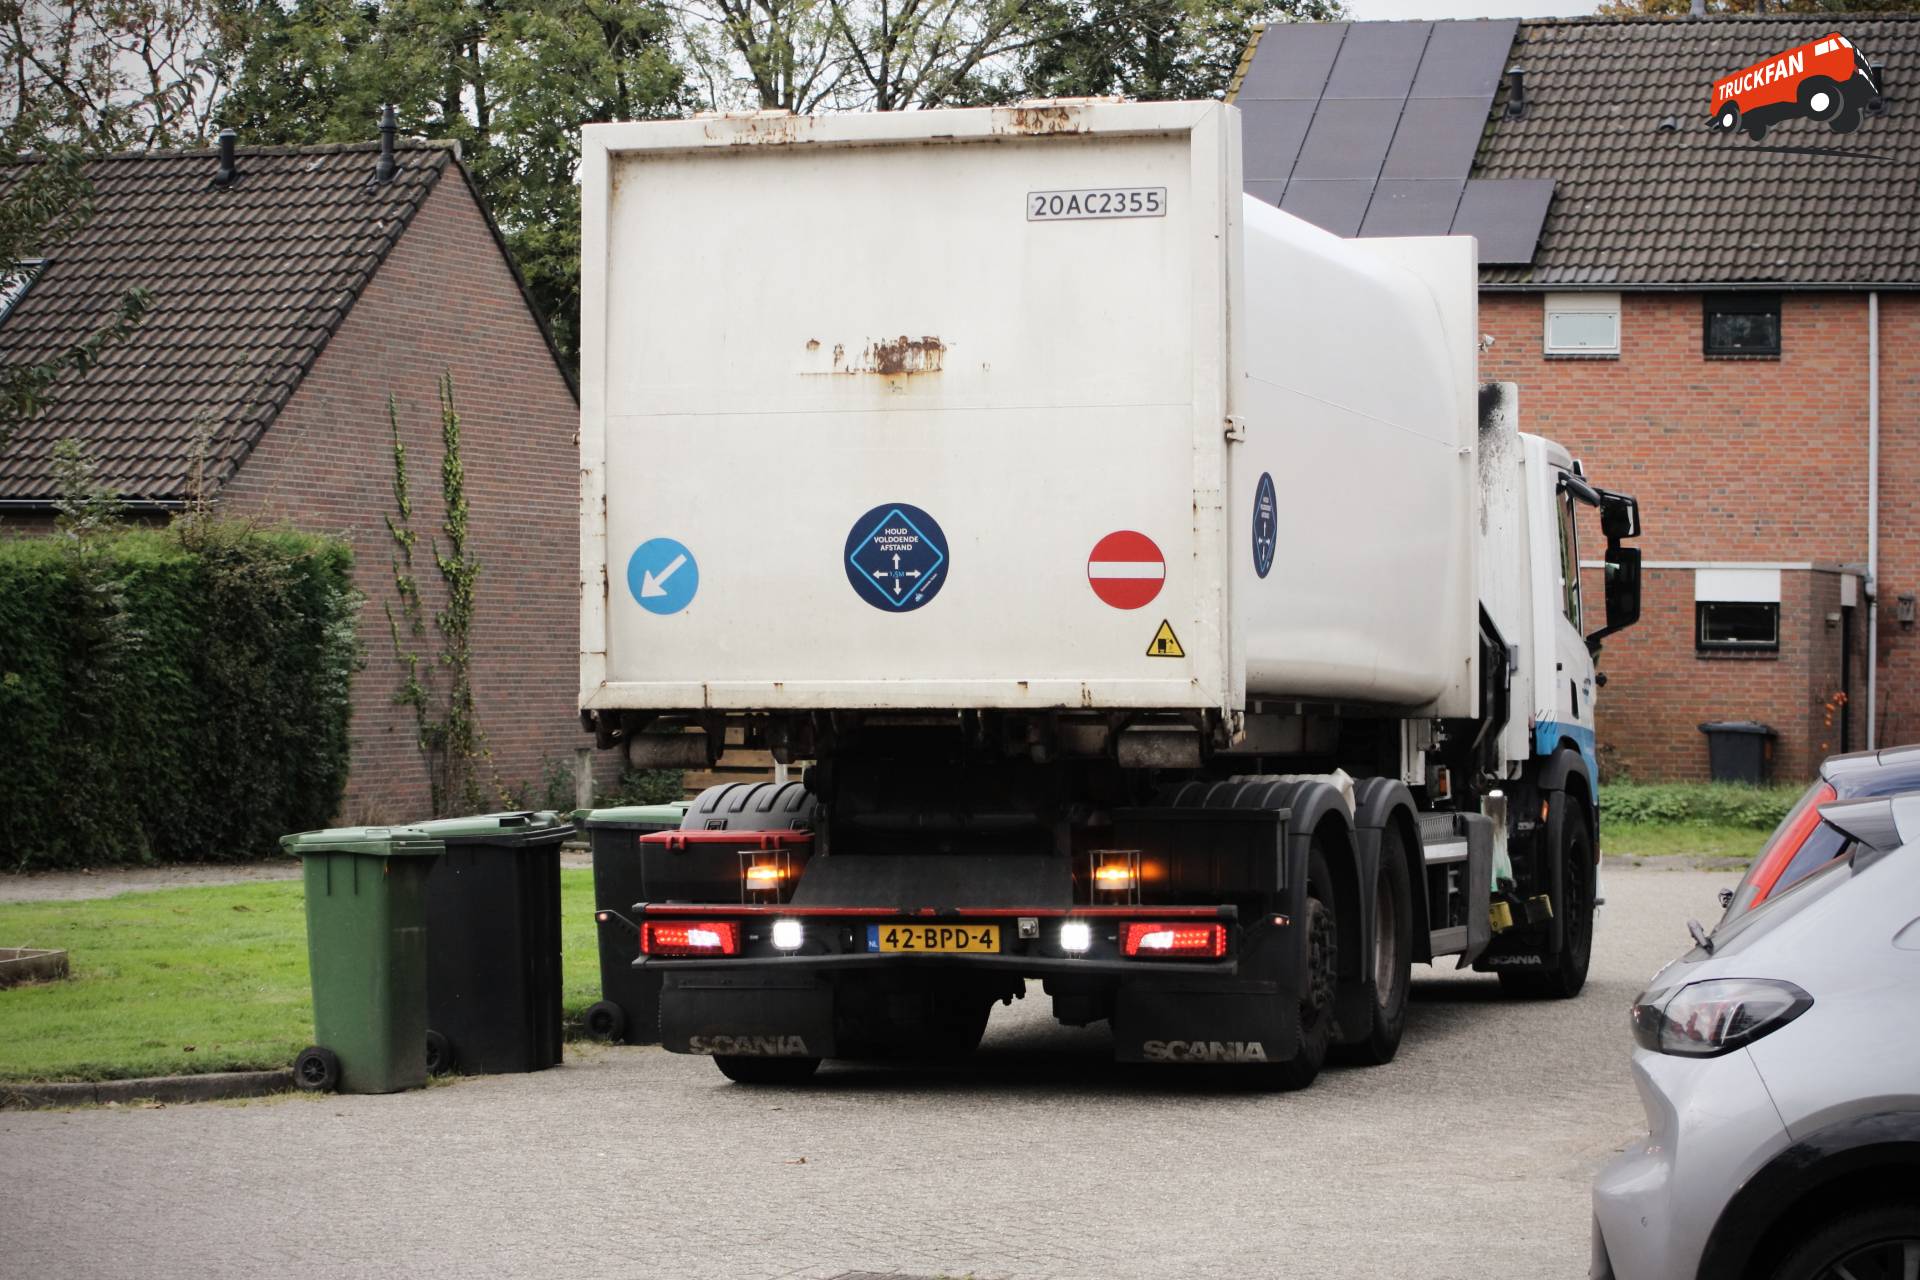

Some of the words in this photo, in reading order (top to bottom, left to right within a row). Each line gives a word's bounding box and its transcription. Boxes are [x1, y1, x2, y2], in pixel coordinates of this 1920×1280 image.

[1034, 192, 1160, 216] 20AC2355
[868, 940, 879, 948] NL
[885, 928, 993, 949] 42-BPD-4
[1487, 954, 1542, 965] SCANIA
[689, 1035, 809, 1055] SCANIA
[1143, 1040, 1268, 1063] SCANIA
